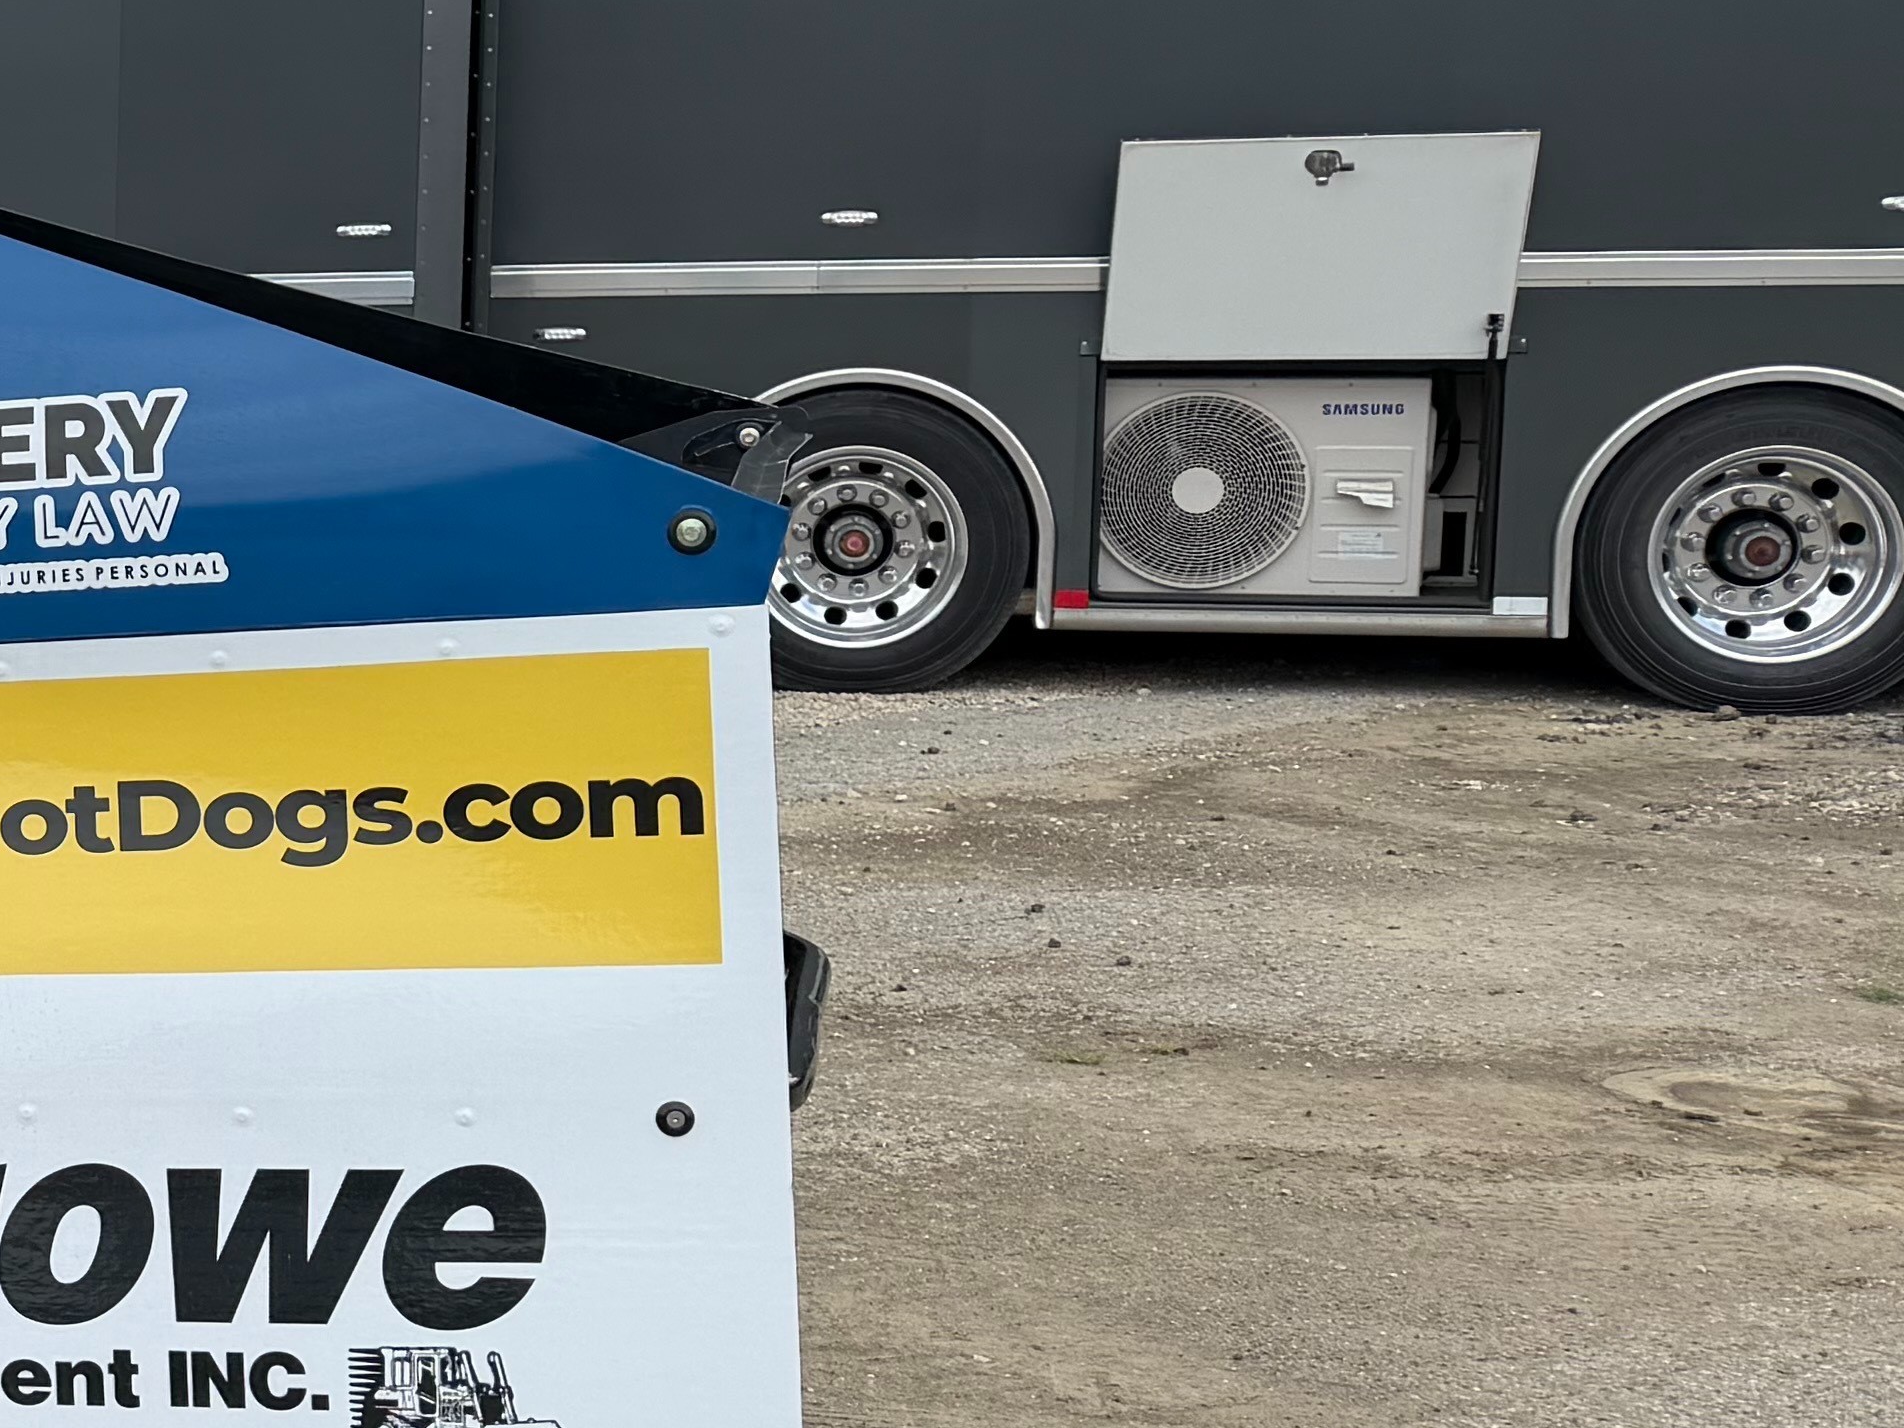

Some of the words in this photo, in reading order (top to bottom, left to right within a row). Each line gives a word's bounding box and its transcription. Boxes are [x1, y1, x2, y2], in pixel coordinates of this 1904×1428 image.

[1321, 403, 1405, 416] SAMSUNG
[40, 492, 172, 542] LAW
[95, 559, 221, 582] PERSONAL
[168, 1349, 331, 1412] INC.
